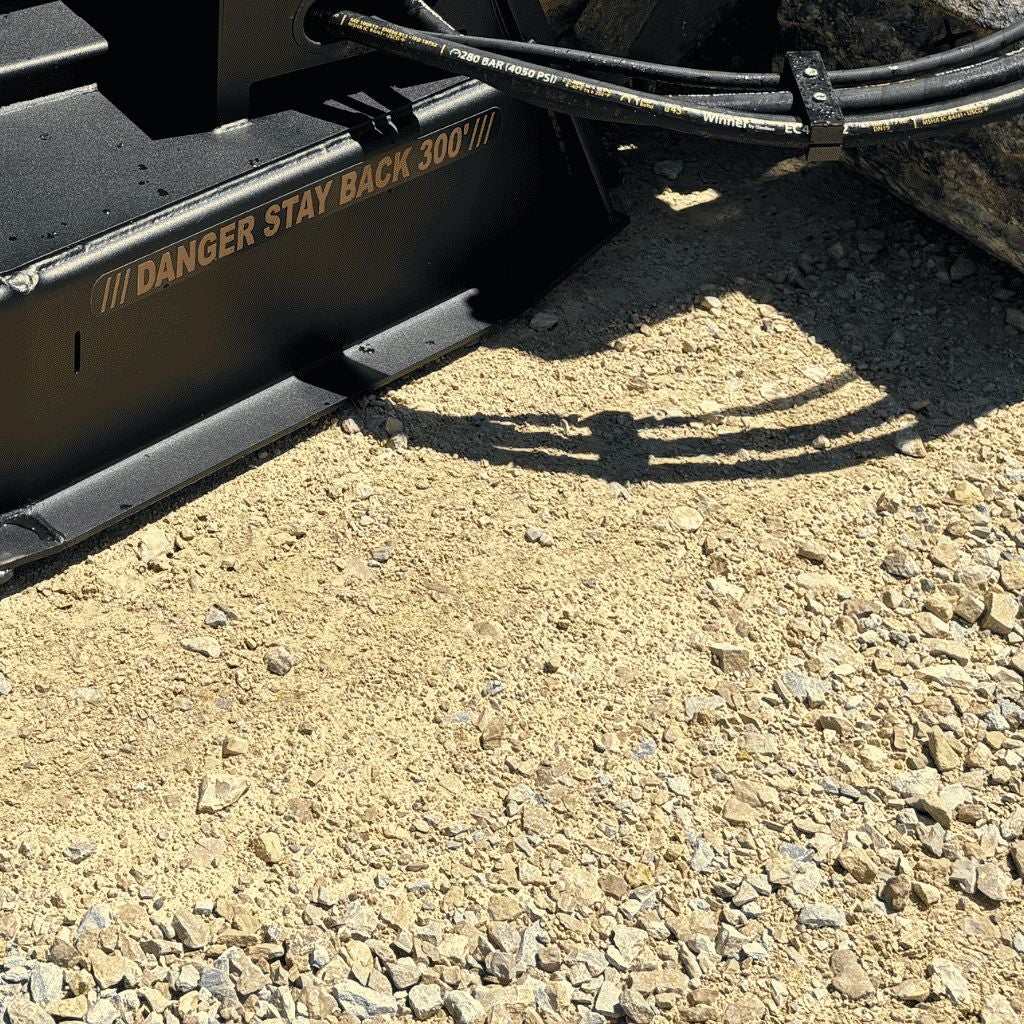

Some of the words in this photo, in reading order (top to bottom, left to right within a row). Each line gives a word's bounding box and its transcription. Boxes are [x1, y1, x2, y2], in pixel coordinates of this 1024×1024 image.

[460, 51, 480, 64] 280
[481, 57, 505, 70] BAR
[505, 62, 537, 78] (4050
[536, 72, 557, 84] PSI)
[136, 214, 256, 296] DANGER
[264, 181, 334, 239] STAY
[339, 146, 413, 205] BACK
[418, 123, 470, 171] 300'
